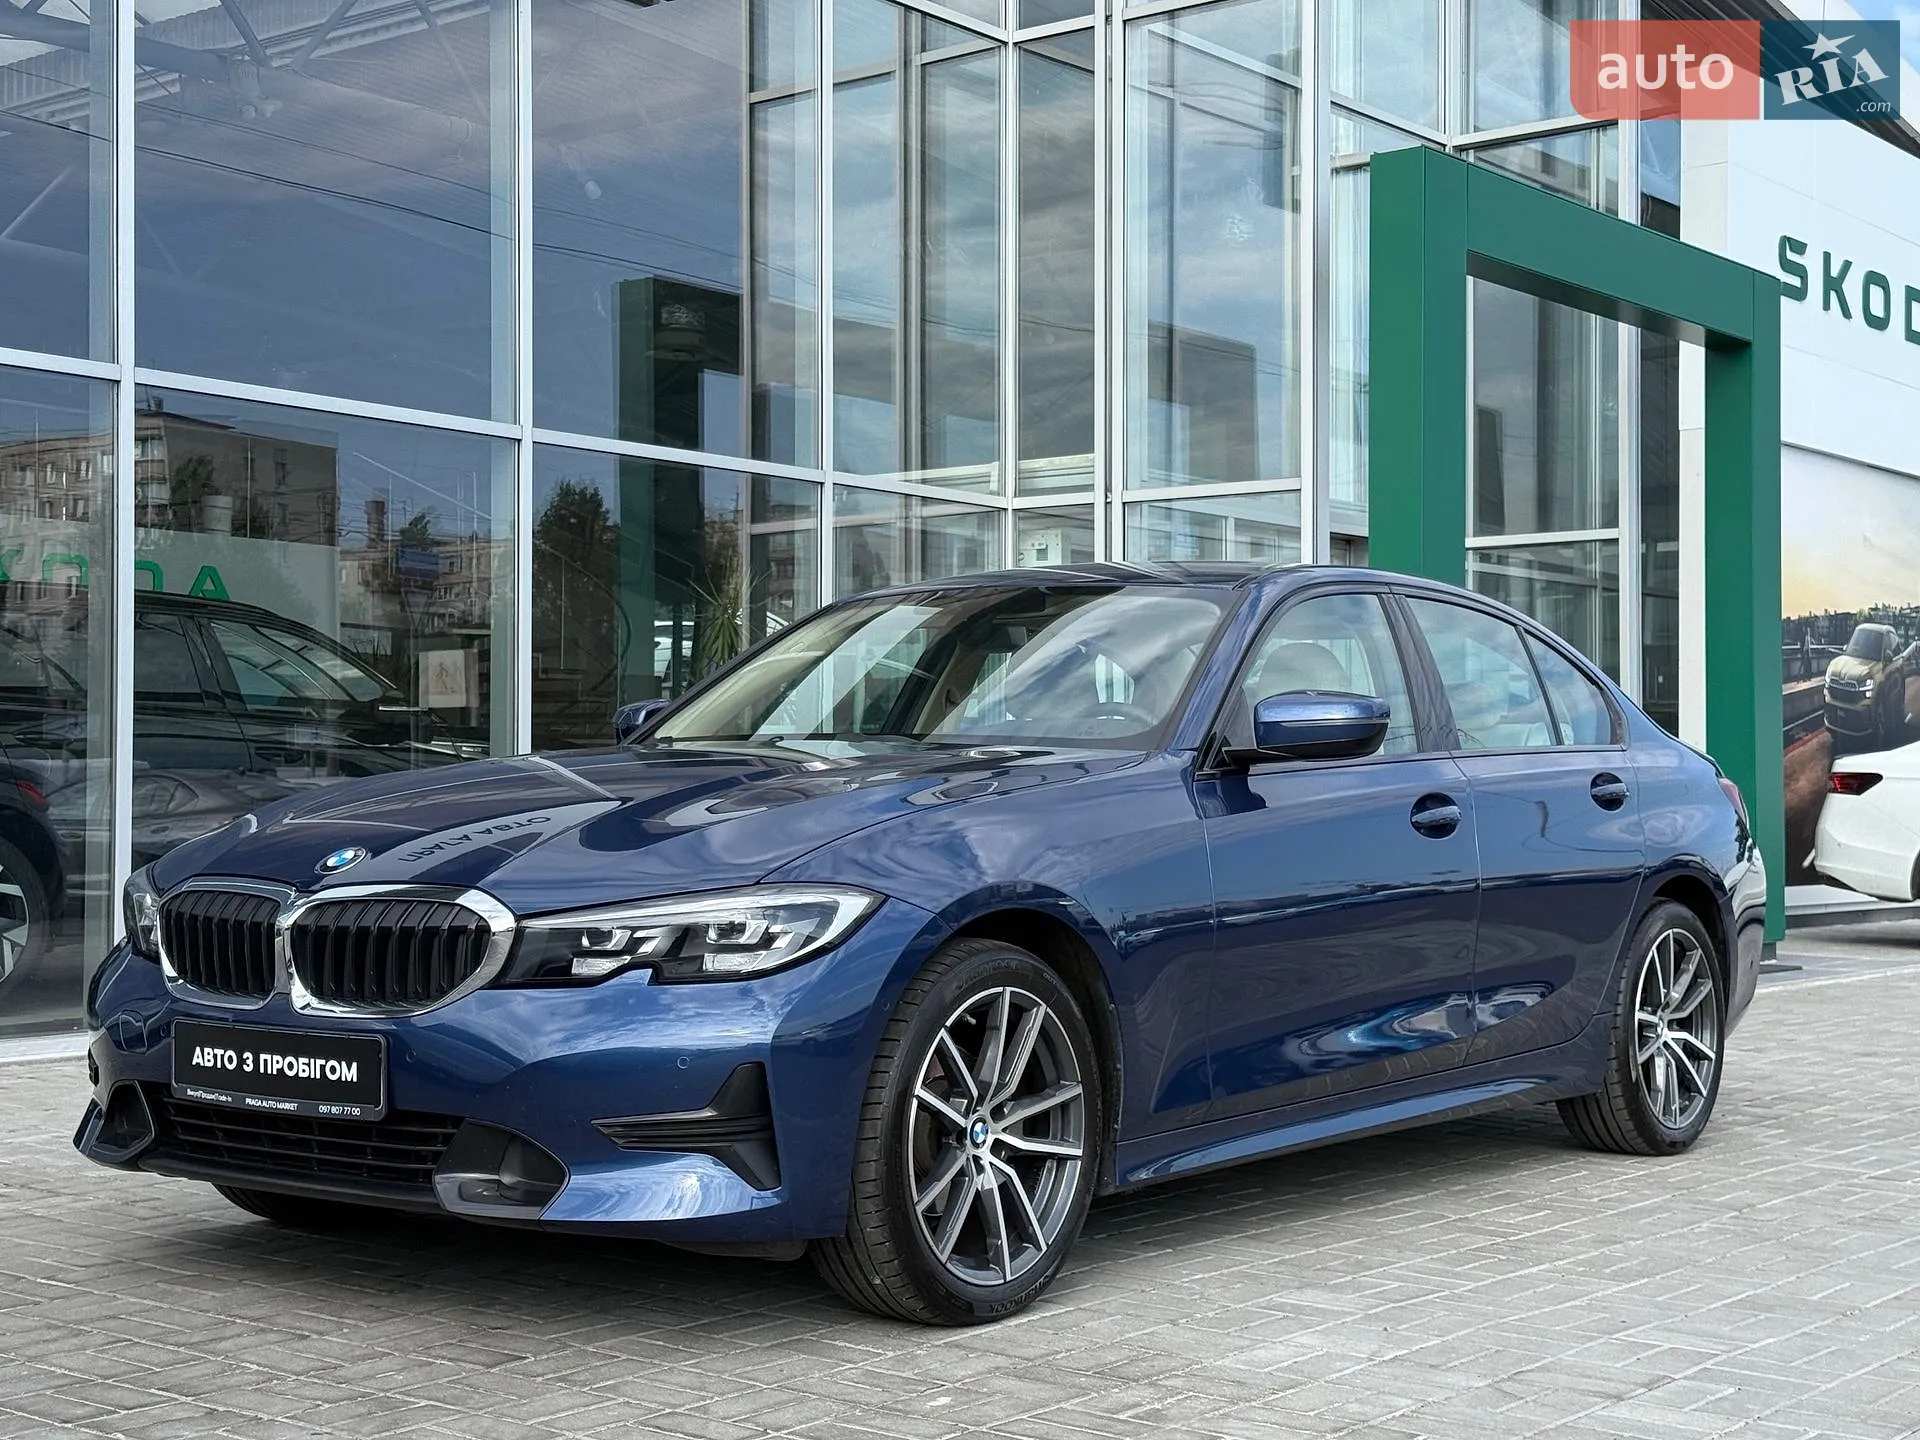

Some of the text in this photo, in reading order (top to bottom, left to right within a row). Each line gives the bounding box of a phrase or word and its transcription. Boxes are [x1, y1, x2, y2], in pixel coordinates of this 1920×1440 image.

[192, 1046, 358, 1082] АВТО З ПРОБІГОМ
[261, 1100, 276, 1109] AUTO
[276, 1102, 298, 1111] MARKET
[319, 1105, 360, 1116] 097 807 77 00
